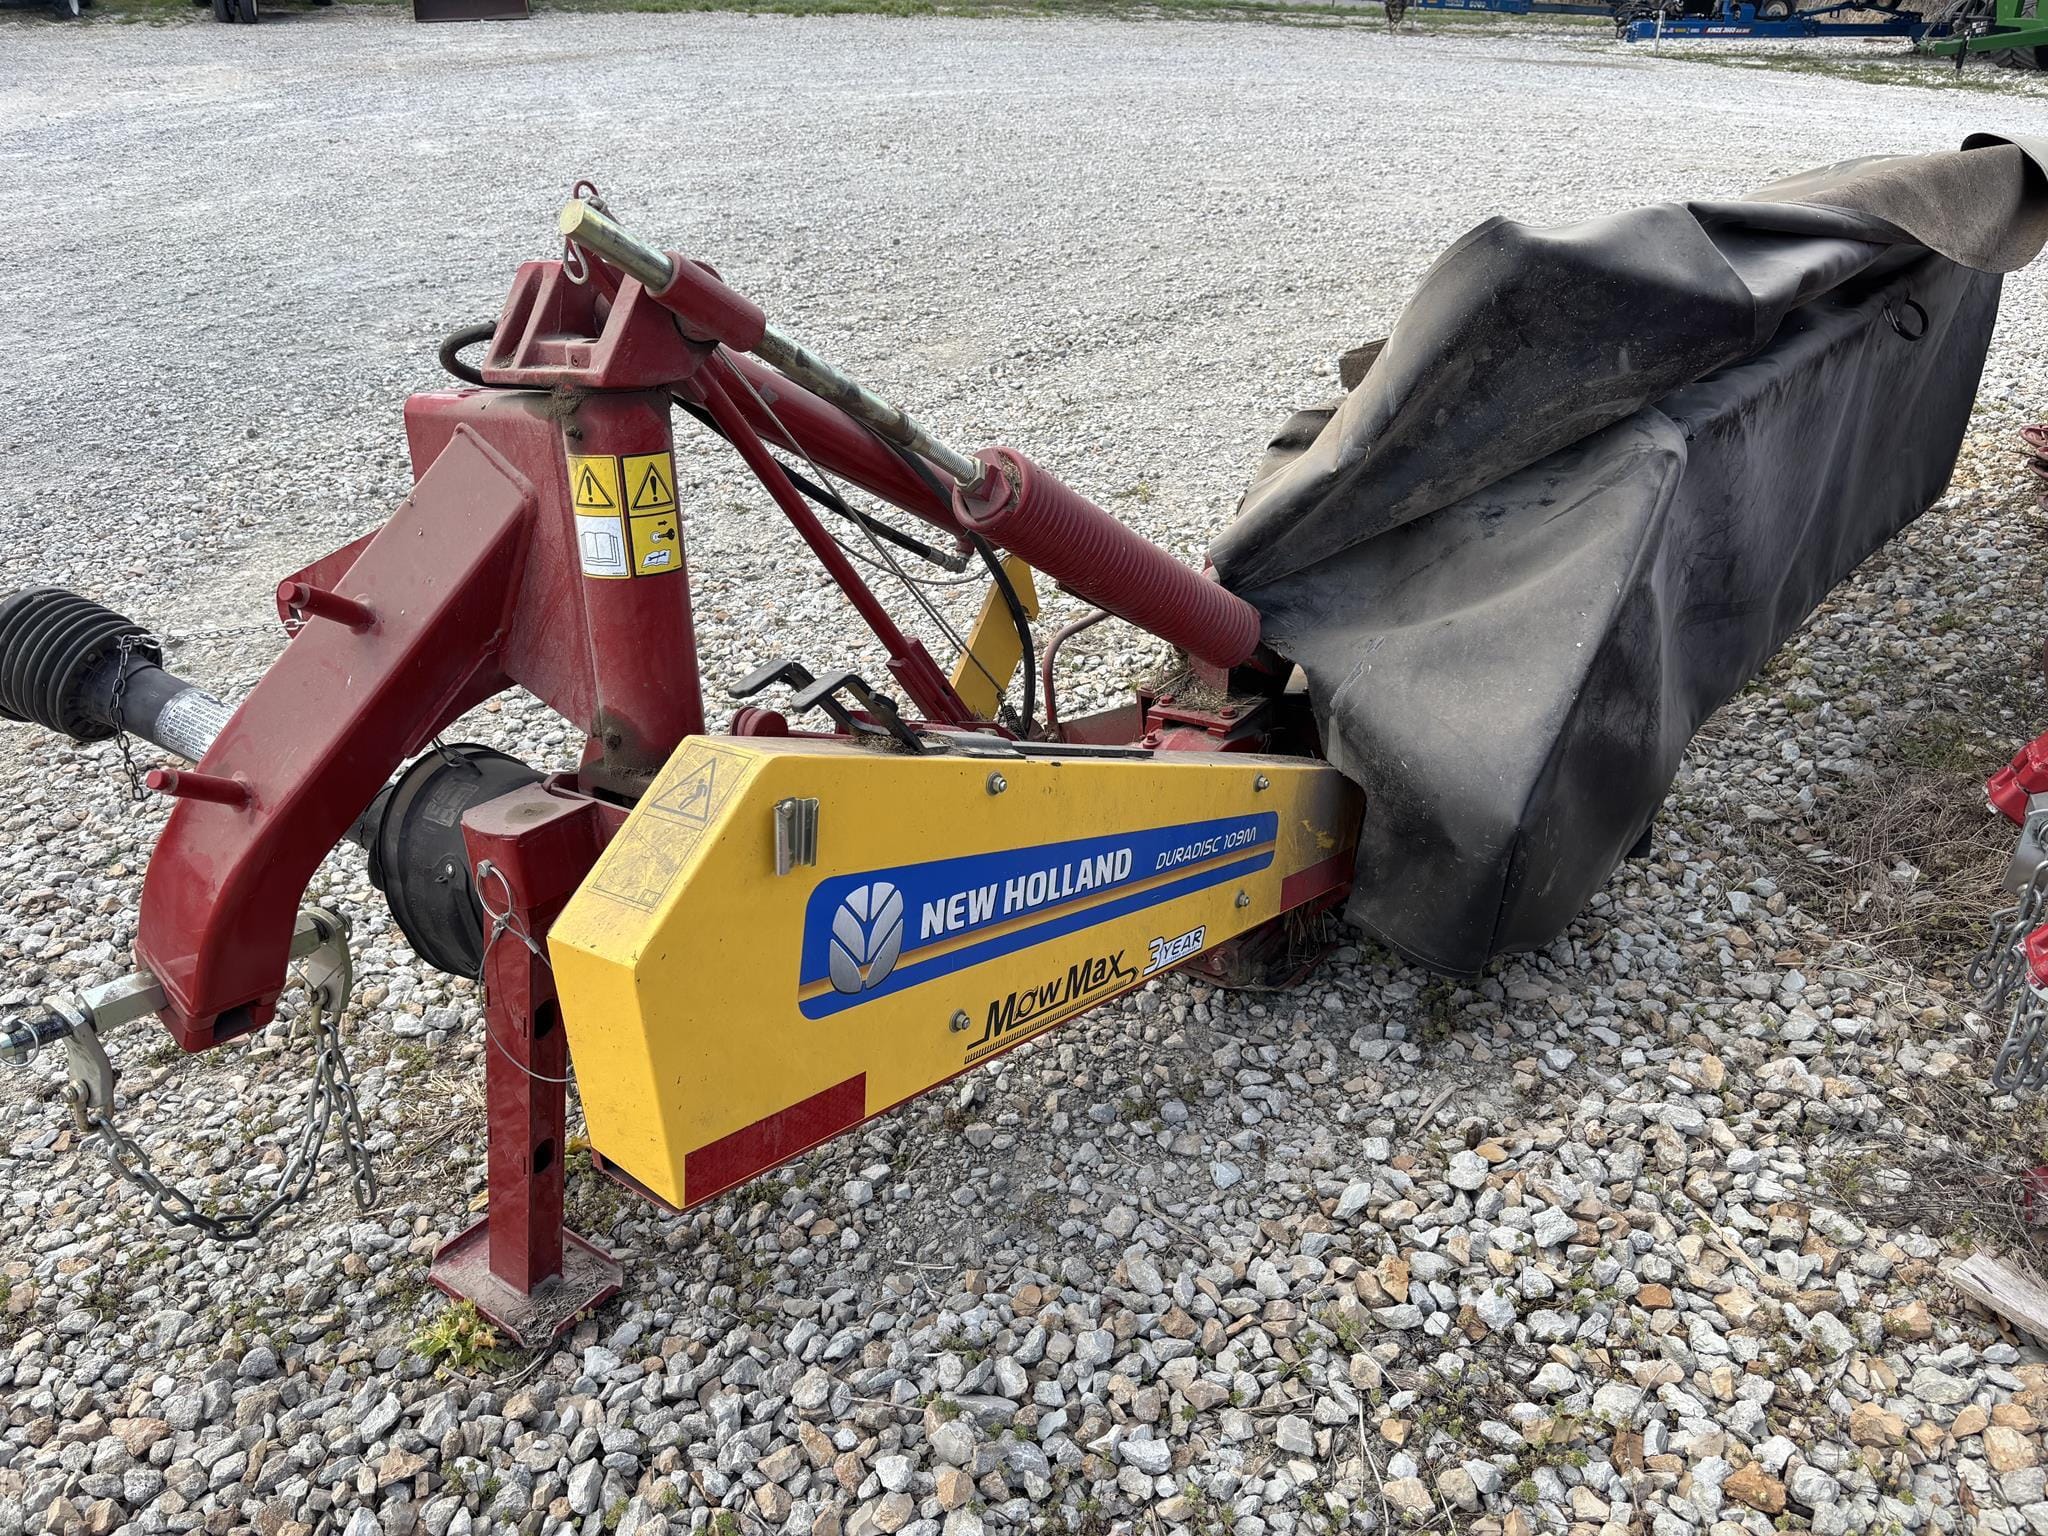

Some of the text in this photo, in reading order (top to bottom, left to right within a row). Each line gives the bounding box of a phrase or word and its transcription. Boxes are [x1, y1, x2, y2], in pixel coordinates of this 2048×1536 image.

[920, 827, 1257, 940] NEW HOLLAND DURADISC 109M
[1163, 929, 1202, 959] YEAR
